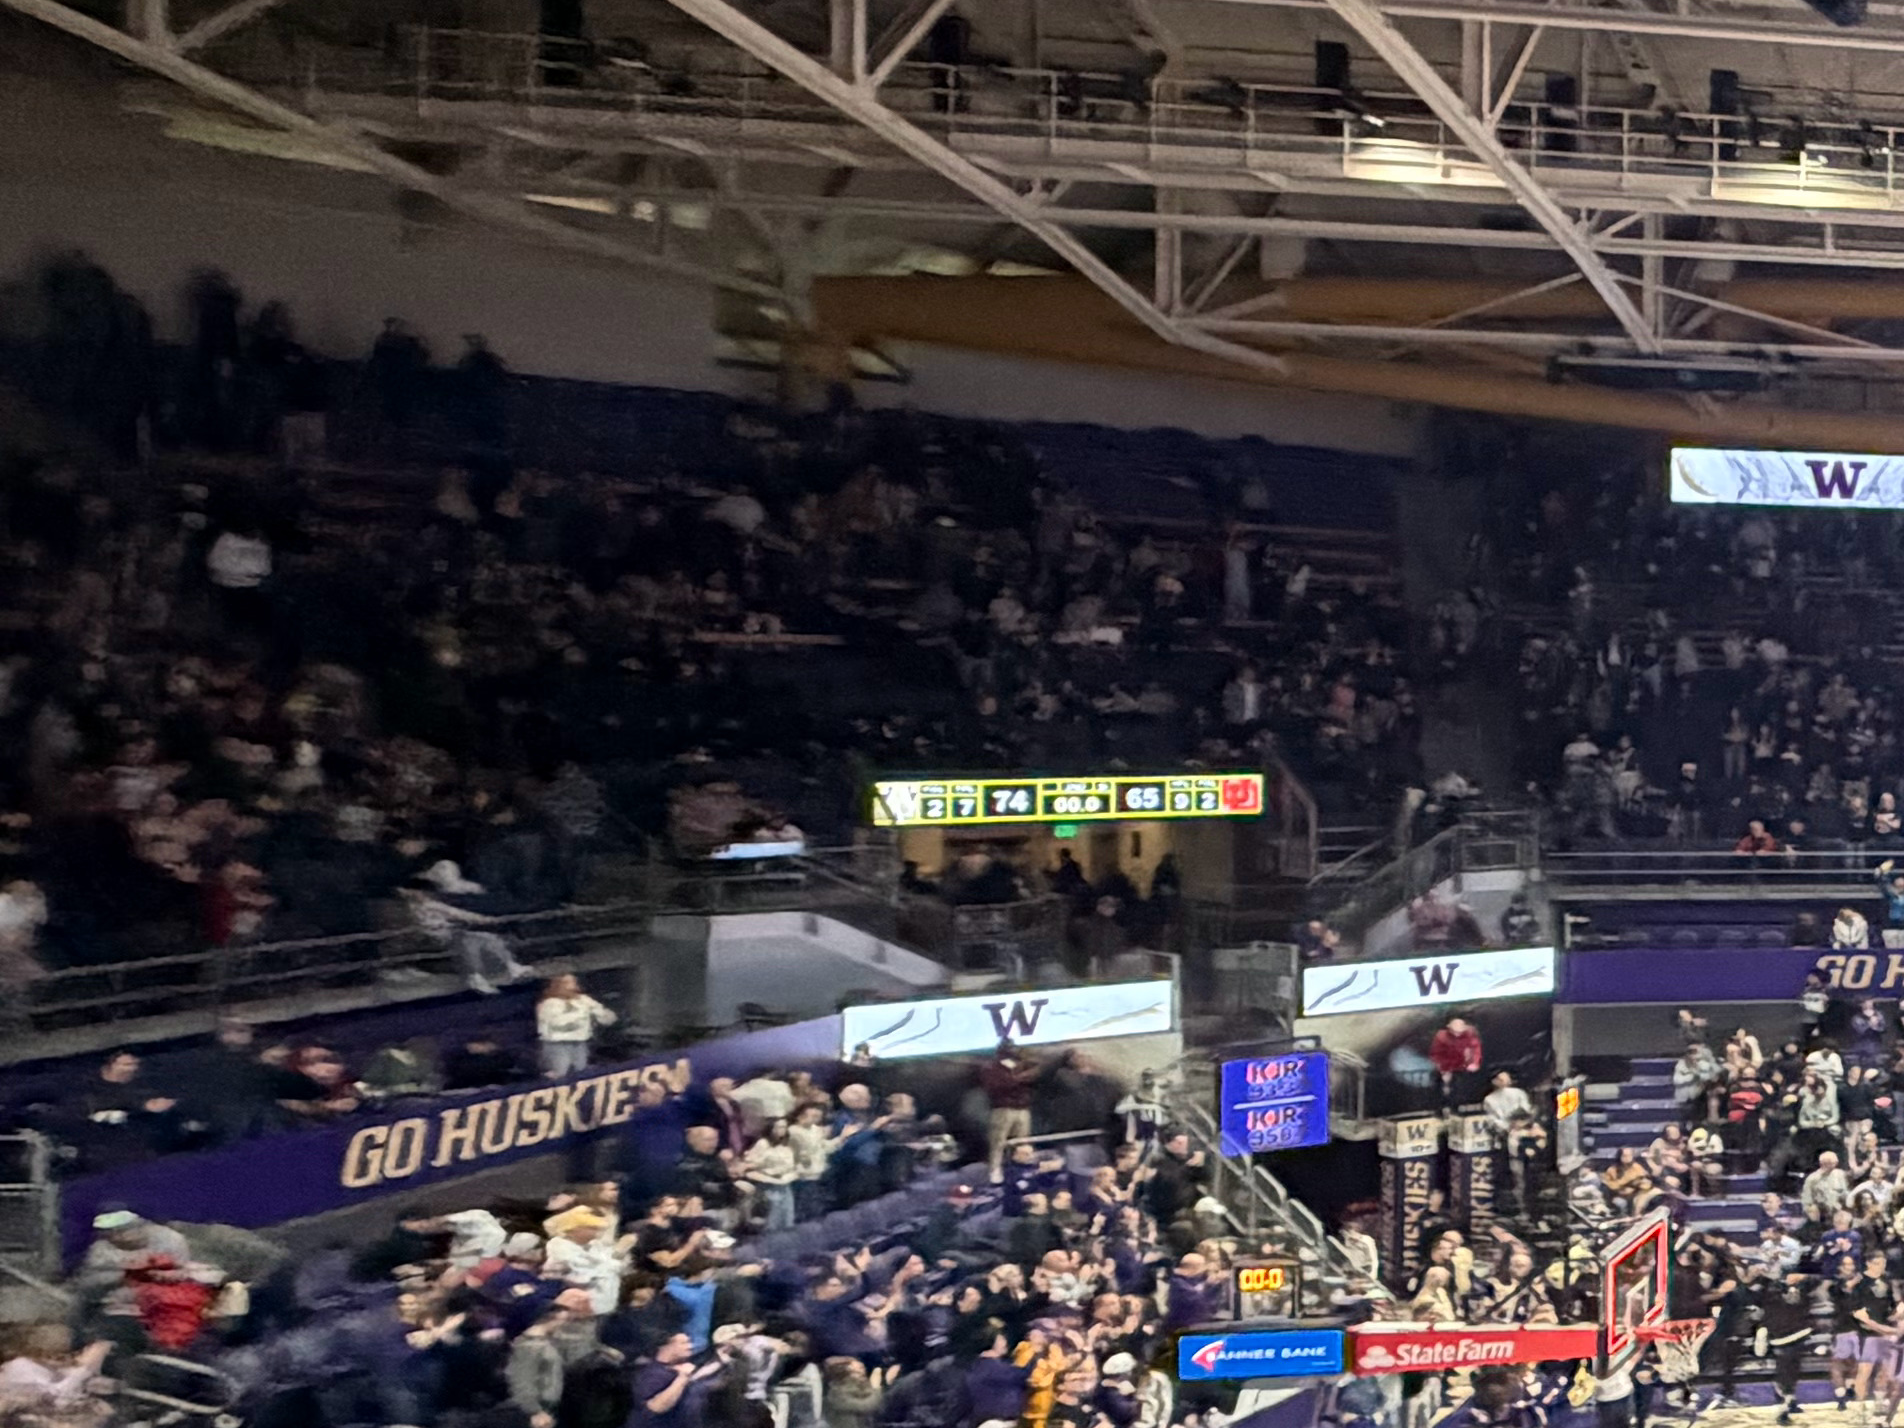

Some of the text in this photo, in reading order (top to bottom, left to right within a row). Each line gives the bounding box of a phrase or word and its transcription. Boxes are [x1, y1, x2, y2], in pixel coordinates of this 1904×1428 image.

[1804, 460, 1868, 499] W
[992, 789, 1030, 813] 74
[1125, 787, 1161, 810] 65
[1409, 963, 1461, 996] W
[982, 998, 1049, 1038] W
[340, 1117, 428, 1188] GO
